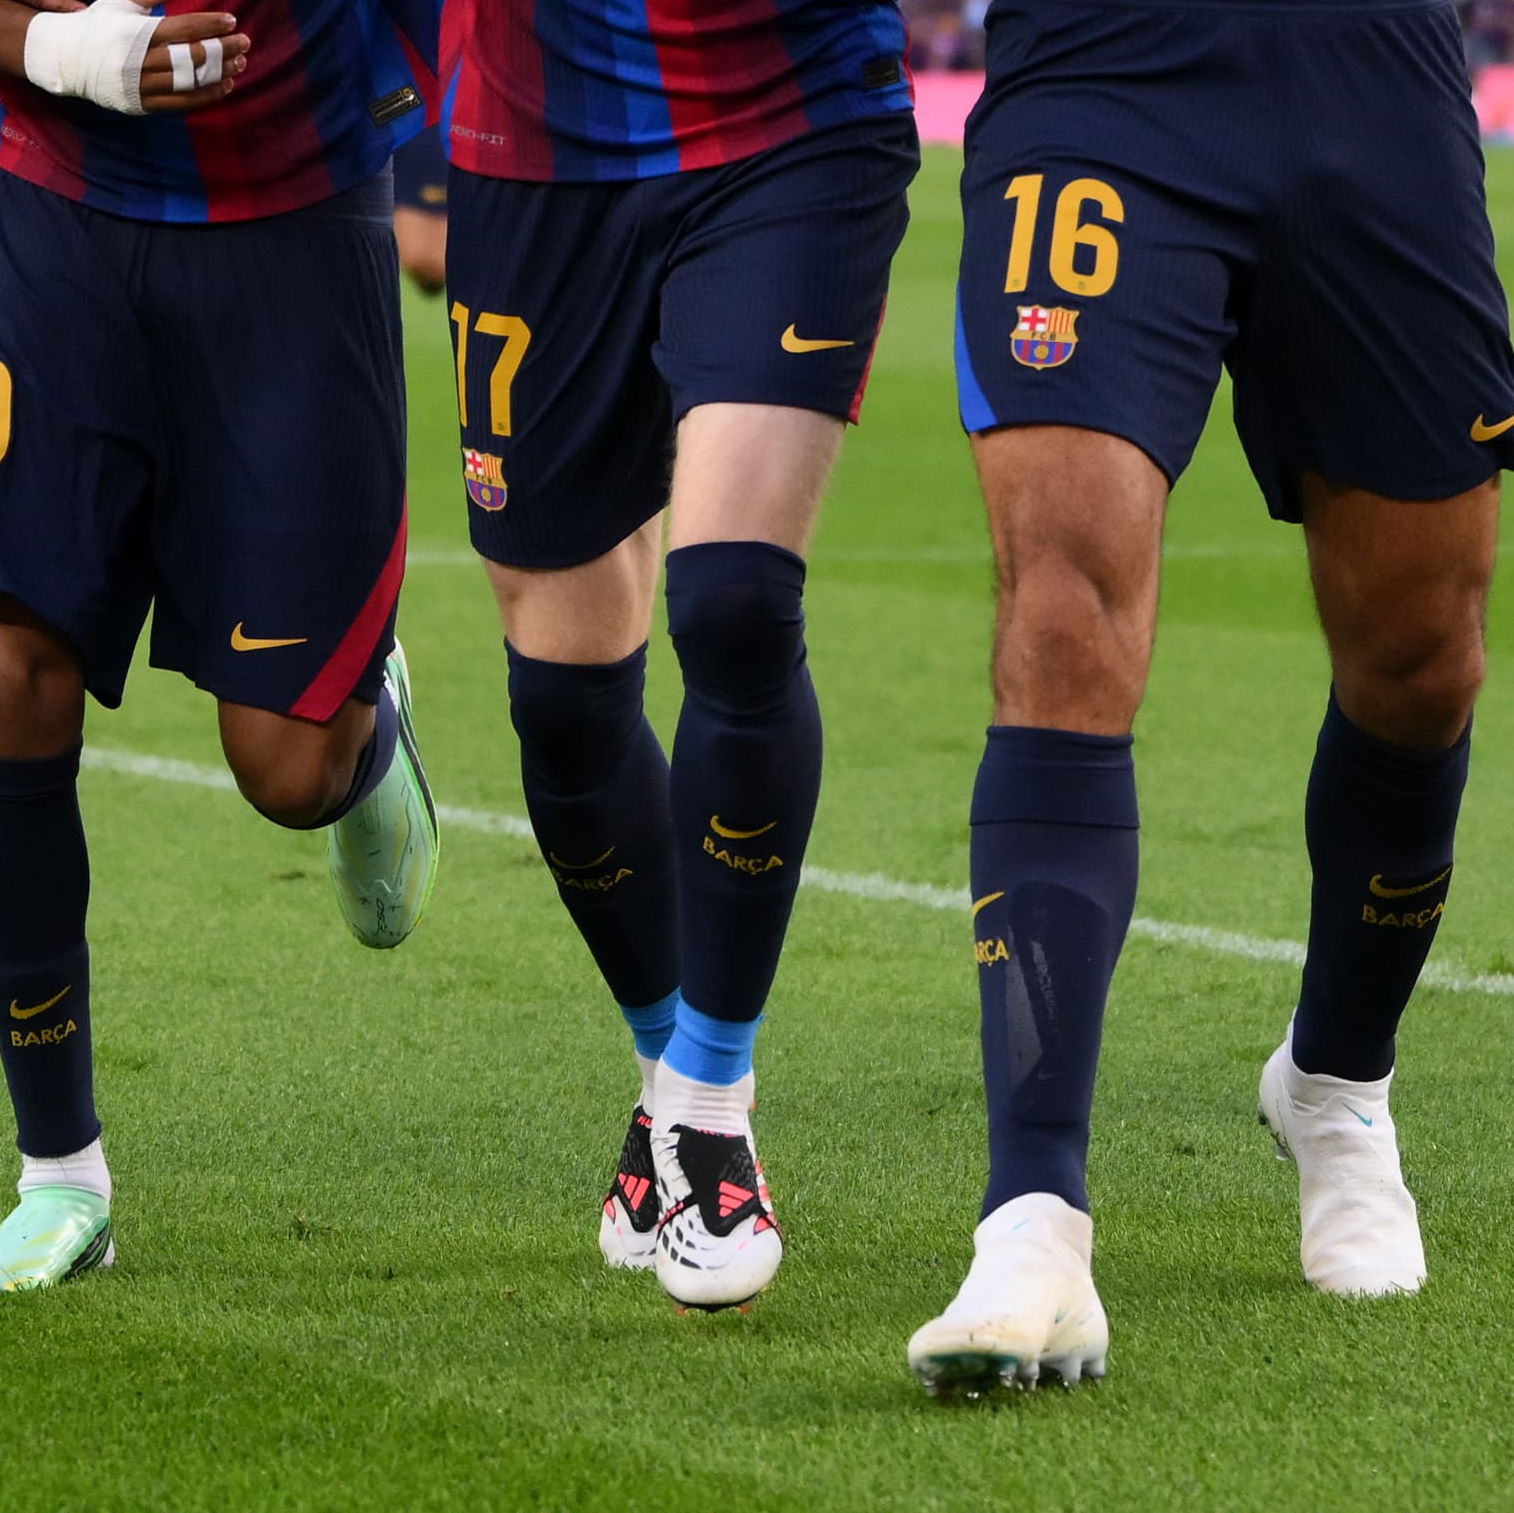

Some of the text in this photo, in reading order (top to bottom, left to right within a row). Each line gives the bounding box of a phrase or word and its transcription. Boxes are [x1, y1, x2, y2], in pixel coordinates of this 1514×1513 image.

[1003, 173, 1125, 297] 16
[1031, 331, 1056, 341] FCB
[450, 301, 532, 437] 17
[702, 836, 784, 875] BARÇA
[10, 1019, 77, 1047] BARÇA
